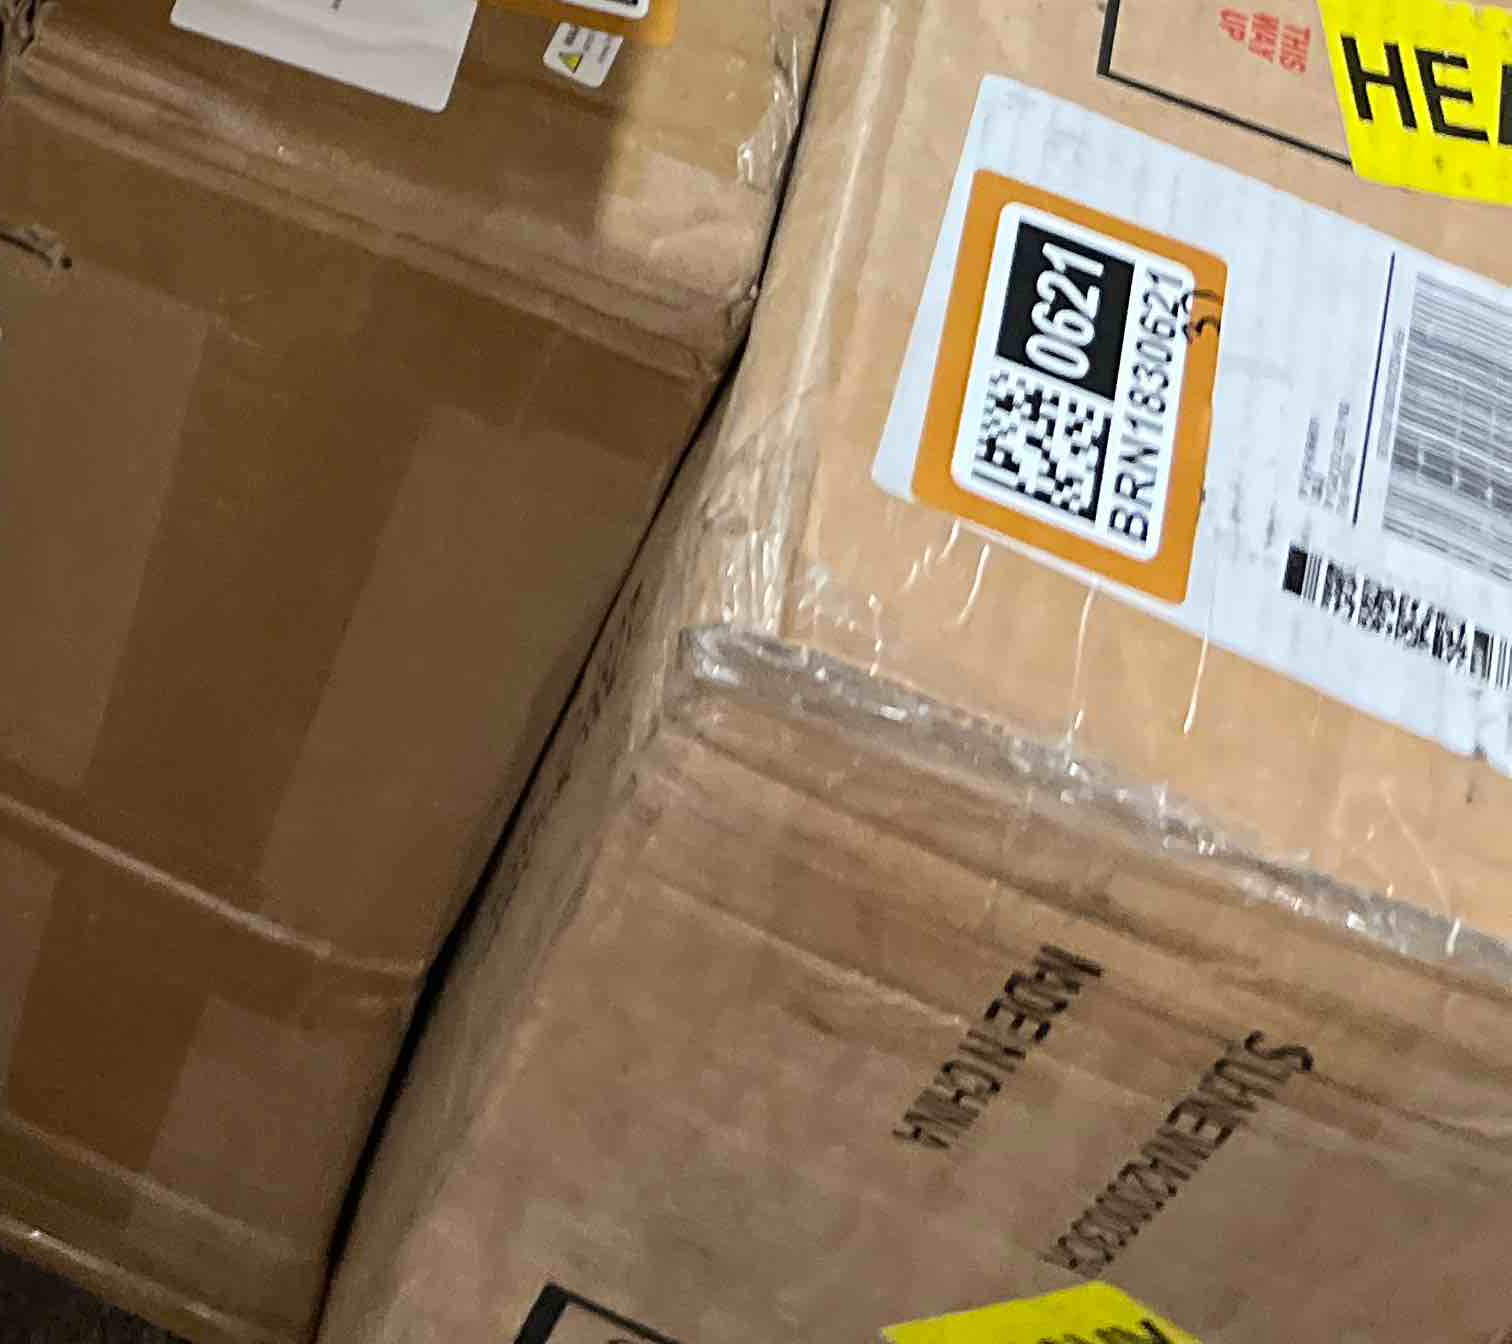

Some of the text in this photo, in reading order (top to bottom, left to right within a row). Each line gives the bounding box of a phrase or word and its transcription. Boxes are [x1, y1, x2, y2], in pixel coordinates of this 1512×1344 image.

[1218, 7, 1248, 42] UP
[1342, 34, 1512, 146] HE
[1025, 241, 1108, 381] 0621
[1108, 265, 1189, 547] BRN1830621
[892, 944, 1105, 1150] MADE IN CHINA
